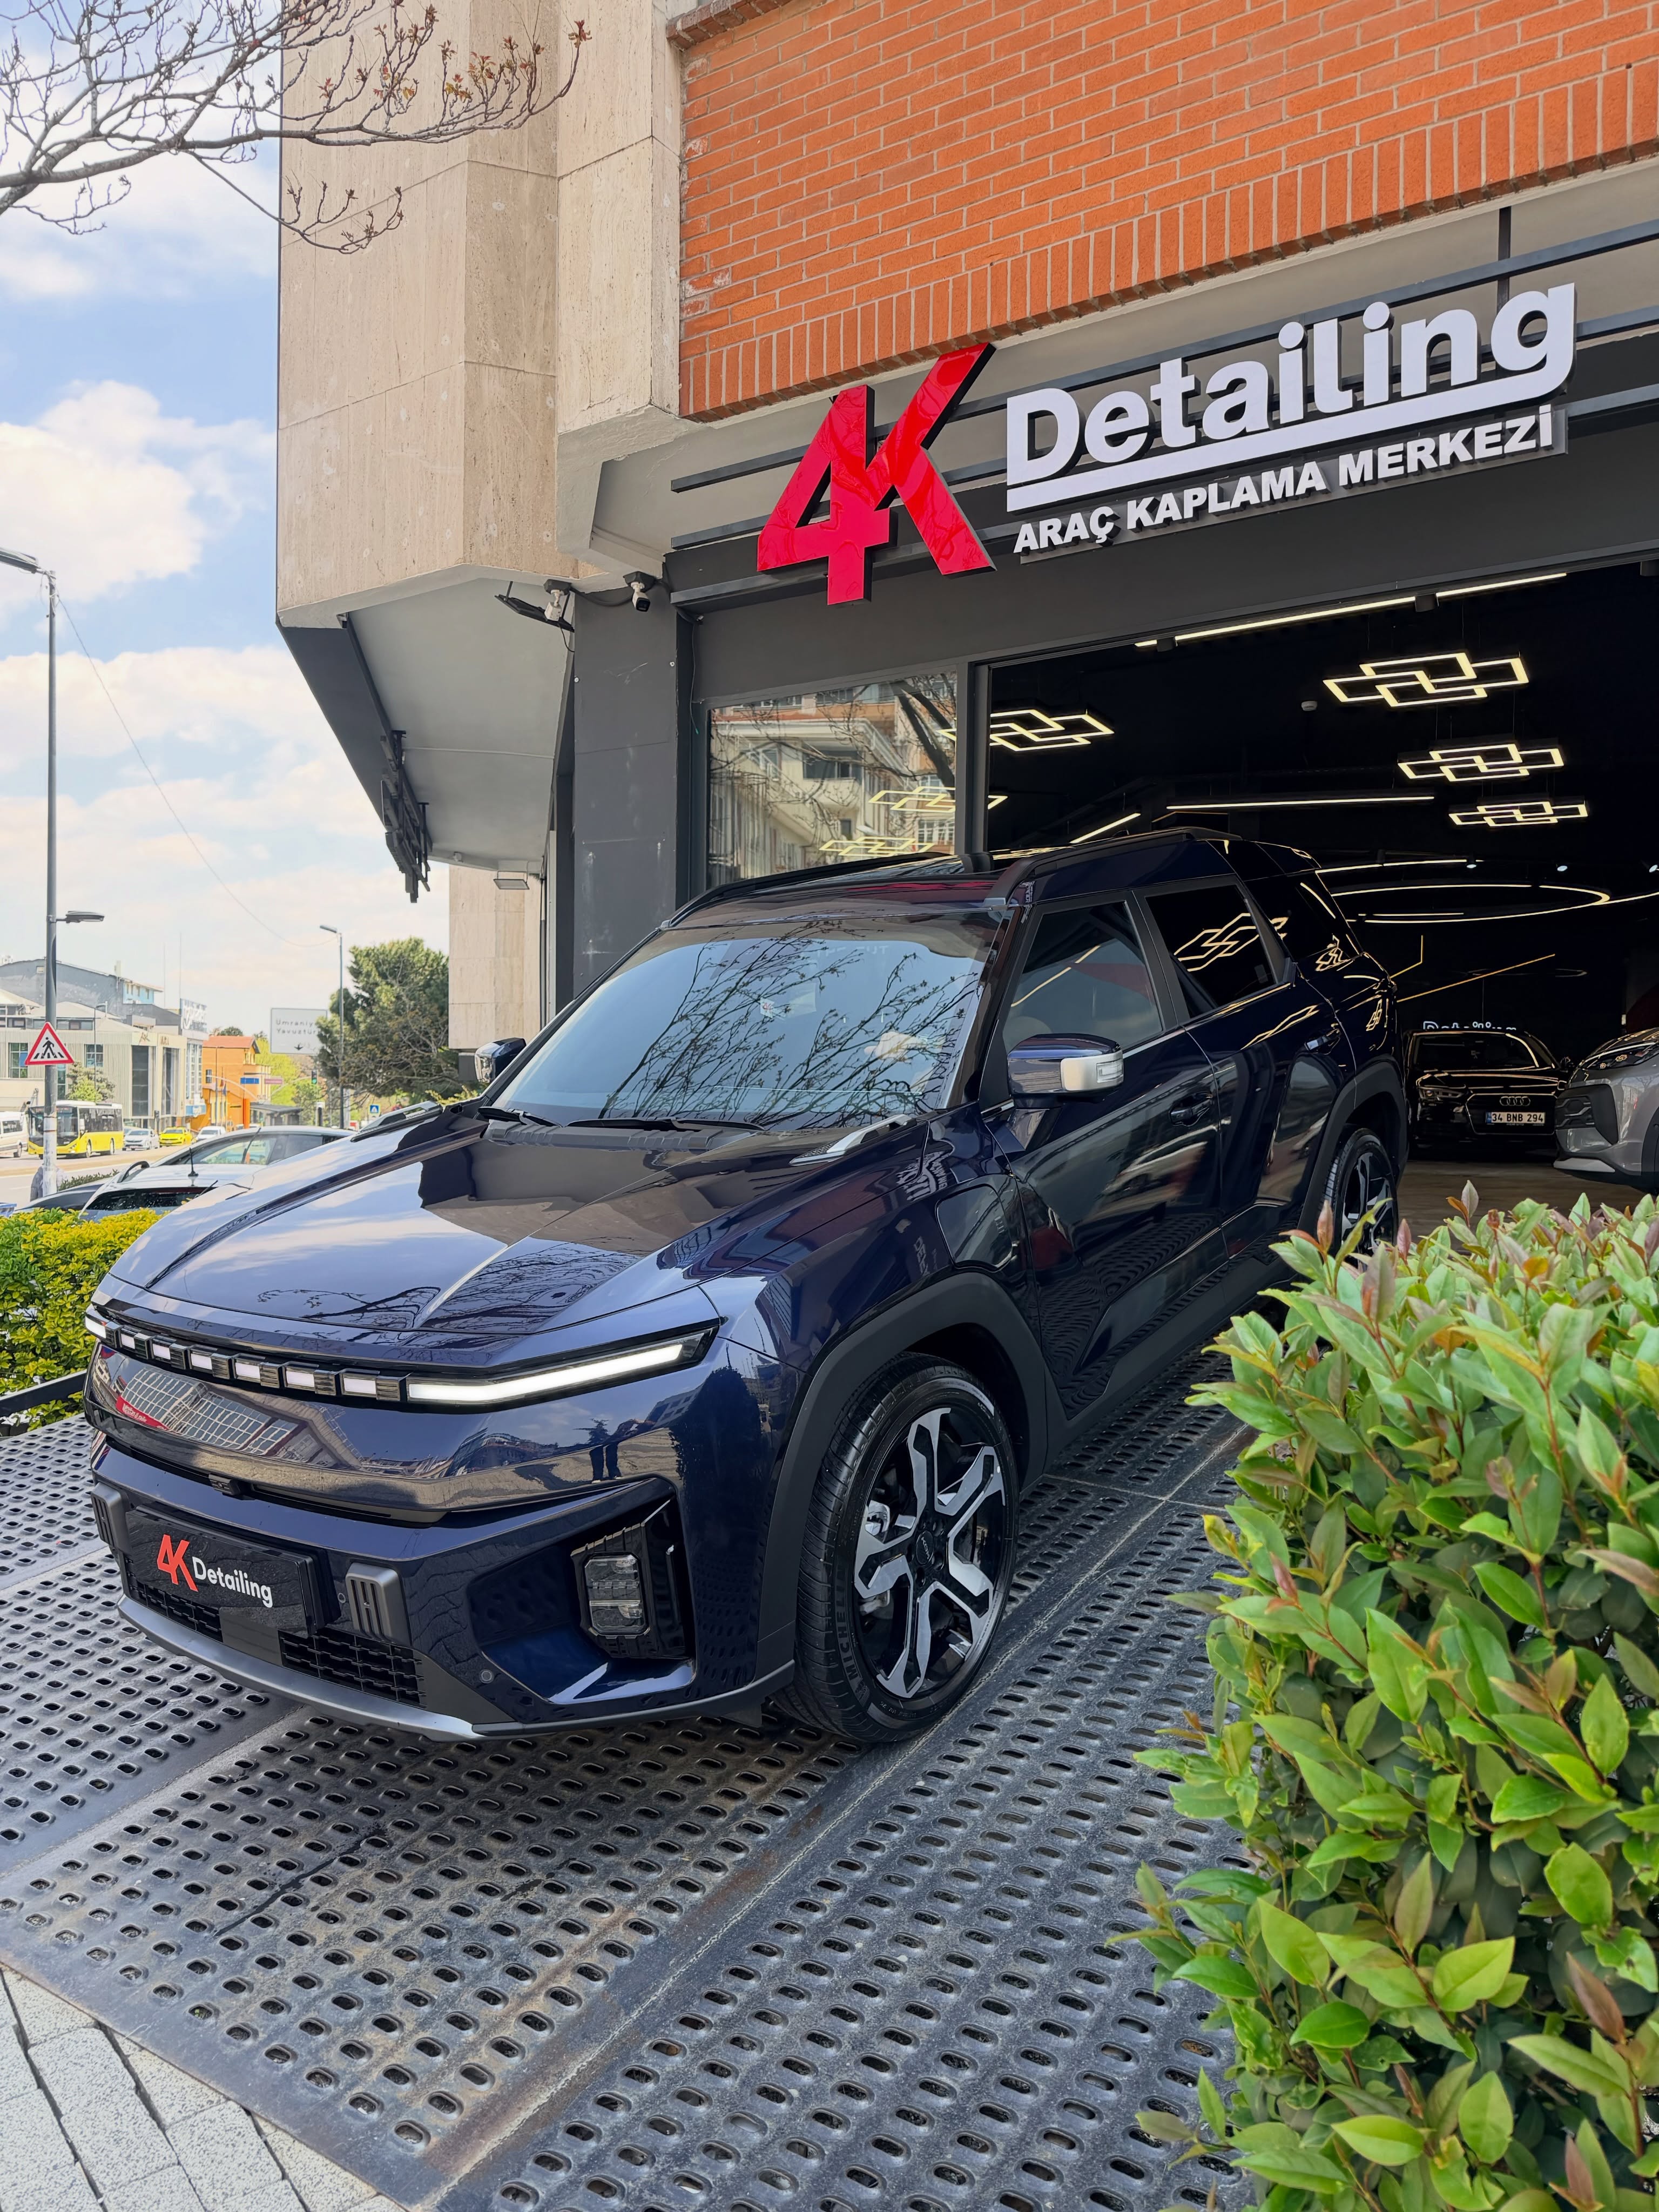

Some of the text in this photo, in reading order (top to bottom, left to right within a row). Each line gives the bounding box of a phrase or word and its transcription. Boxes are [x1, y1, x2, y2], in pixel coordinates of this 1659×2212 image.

[757, 282, 1575, 605] 4K Detailing
[1013, 404, 1553, 554] ARAÇ KAPLAMA MERKEZİ
[1492, 1113, 1543, 1122] 34 BNB 294
[157, 1534, 273, 1608] 4K Detailing
